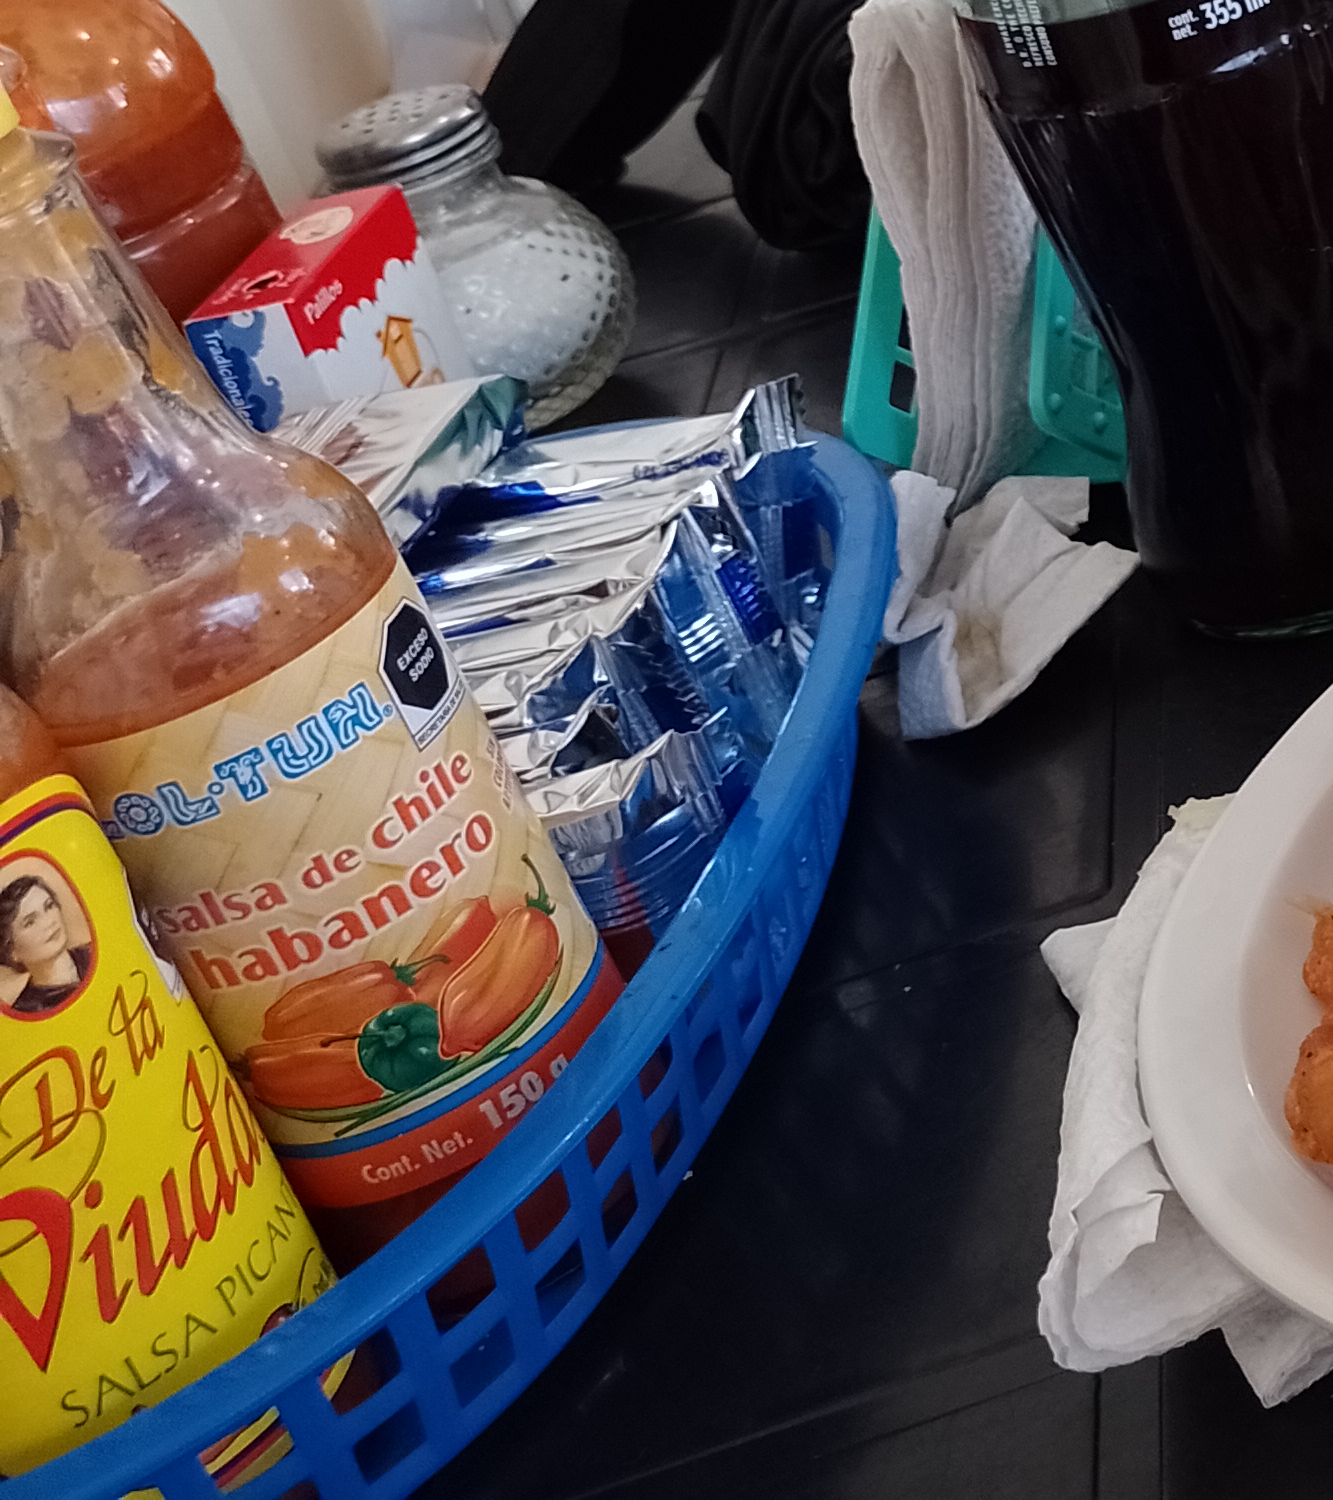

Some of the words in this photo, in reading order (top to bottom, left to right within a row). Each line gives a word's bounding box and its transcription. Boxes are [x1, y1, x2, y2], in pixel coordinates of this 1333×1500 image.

[1168, 9, 1199, 28] cont.
[1172, 25, 1198, 41] net.
[1022, 25, 1045, 67] REFRESCO
[1035, 26, 1058, 66] CONSUMO
[396, 627, 429, 672] EXCESO
[408, 646, 435, 683] SODIO
[157, 882, 288, 934] salsa
[303, 848, 361, 890] de
[372, 754, 472, 849] chile
[191, 814, 493, 991] habanero
[361, 1155, 421, 1184] Cont.
[421, 1131, 474, 1163] Net.
[479, 1071, 544, 1130] 150
[61, 1312, 217, 1428] SALSA
